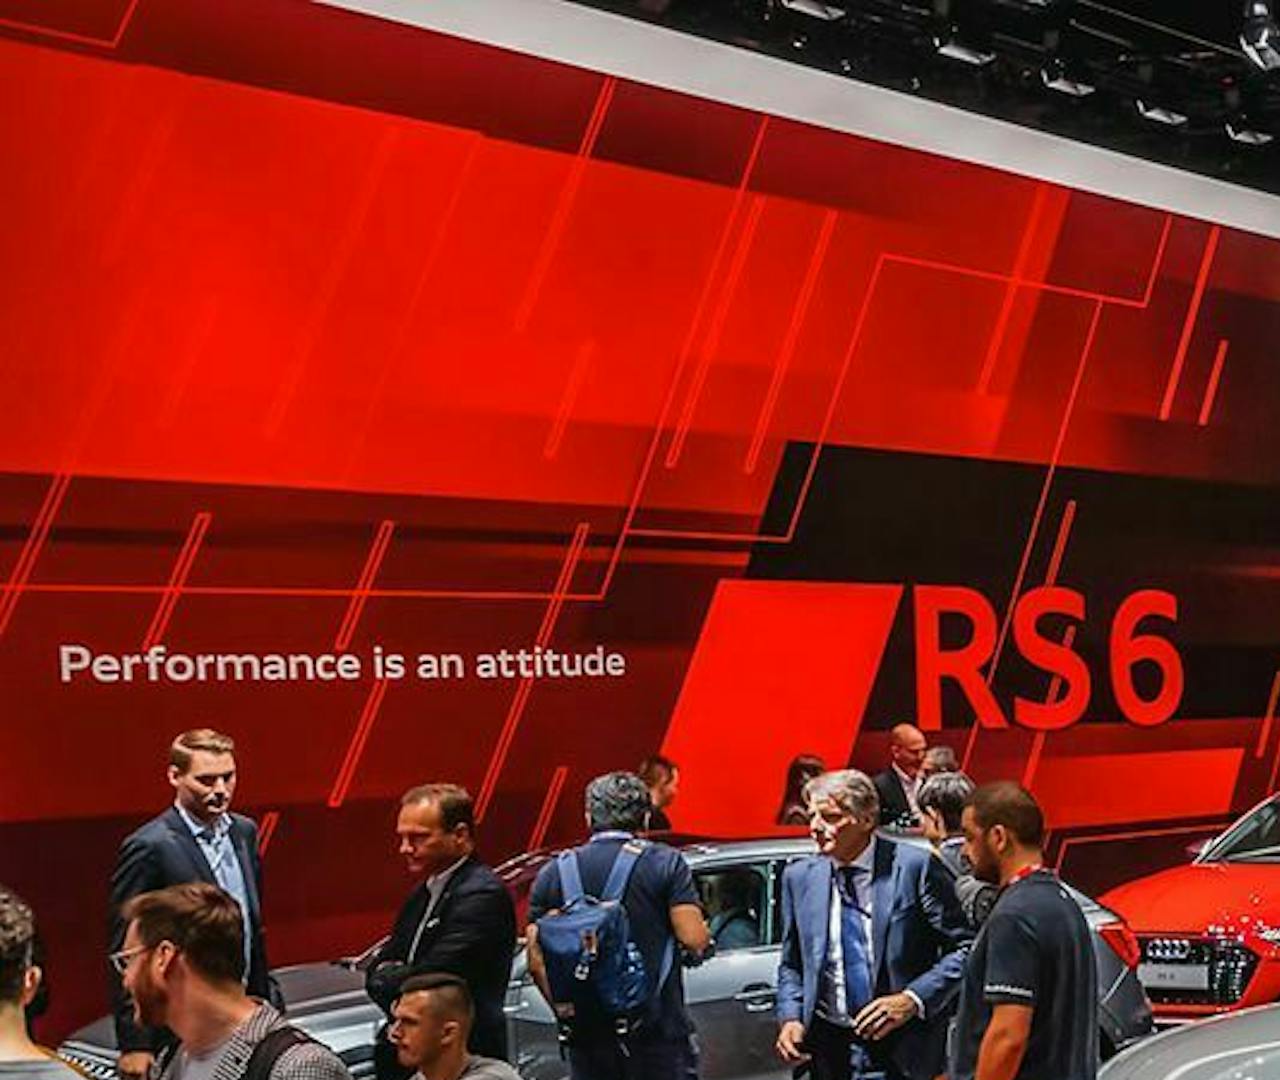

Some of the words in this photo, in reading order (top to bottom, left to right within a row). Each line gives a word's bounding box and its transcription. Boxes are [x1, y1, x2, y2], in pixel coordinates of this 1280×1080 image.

[59, 645, 362, 682] Performance
[373, 646, 405, 680] is
[417, 653, 466, 680] an
[476, 646, 626, 679] attitude
